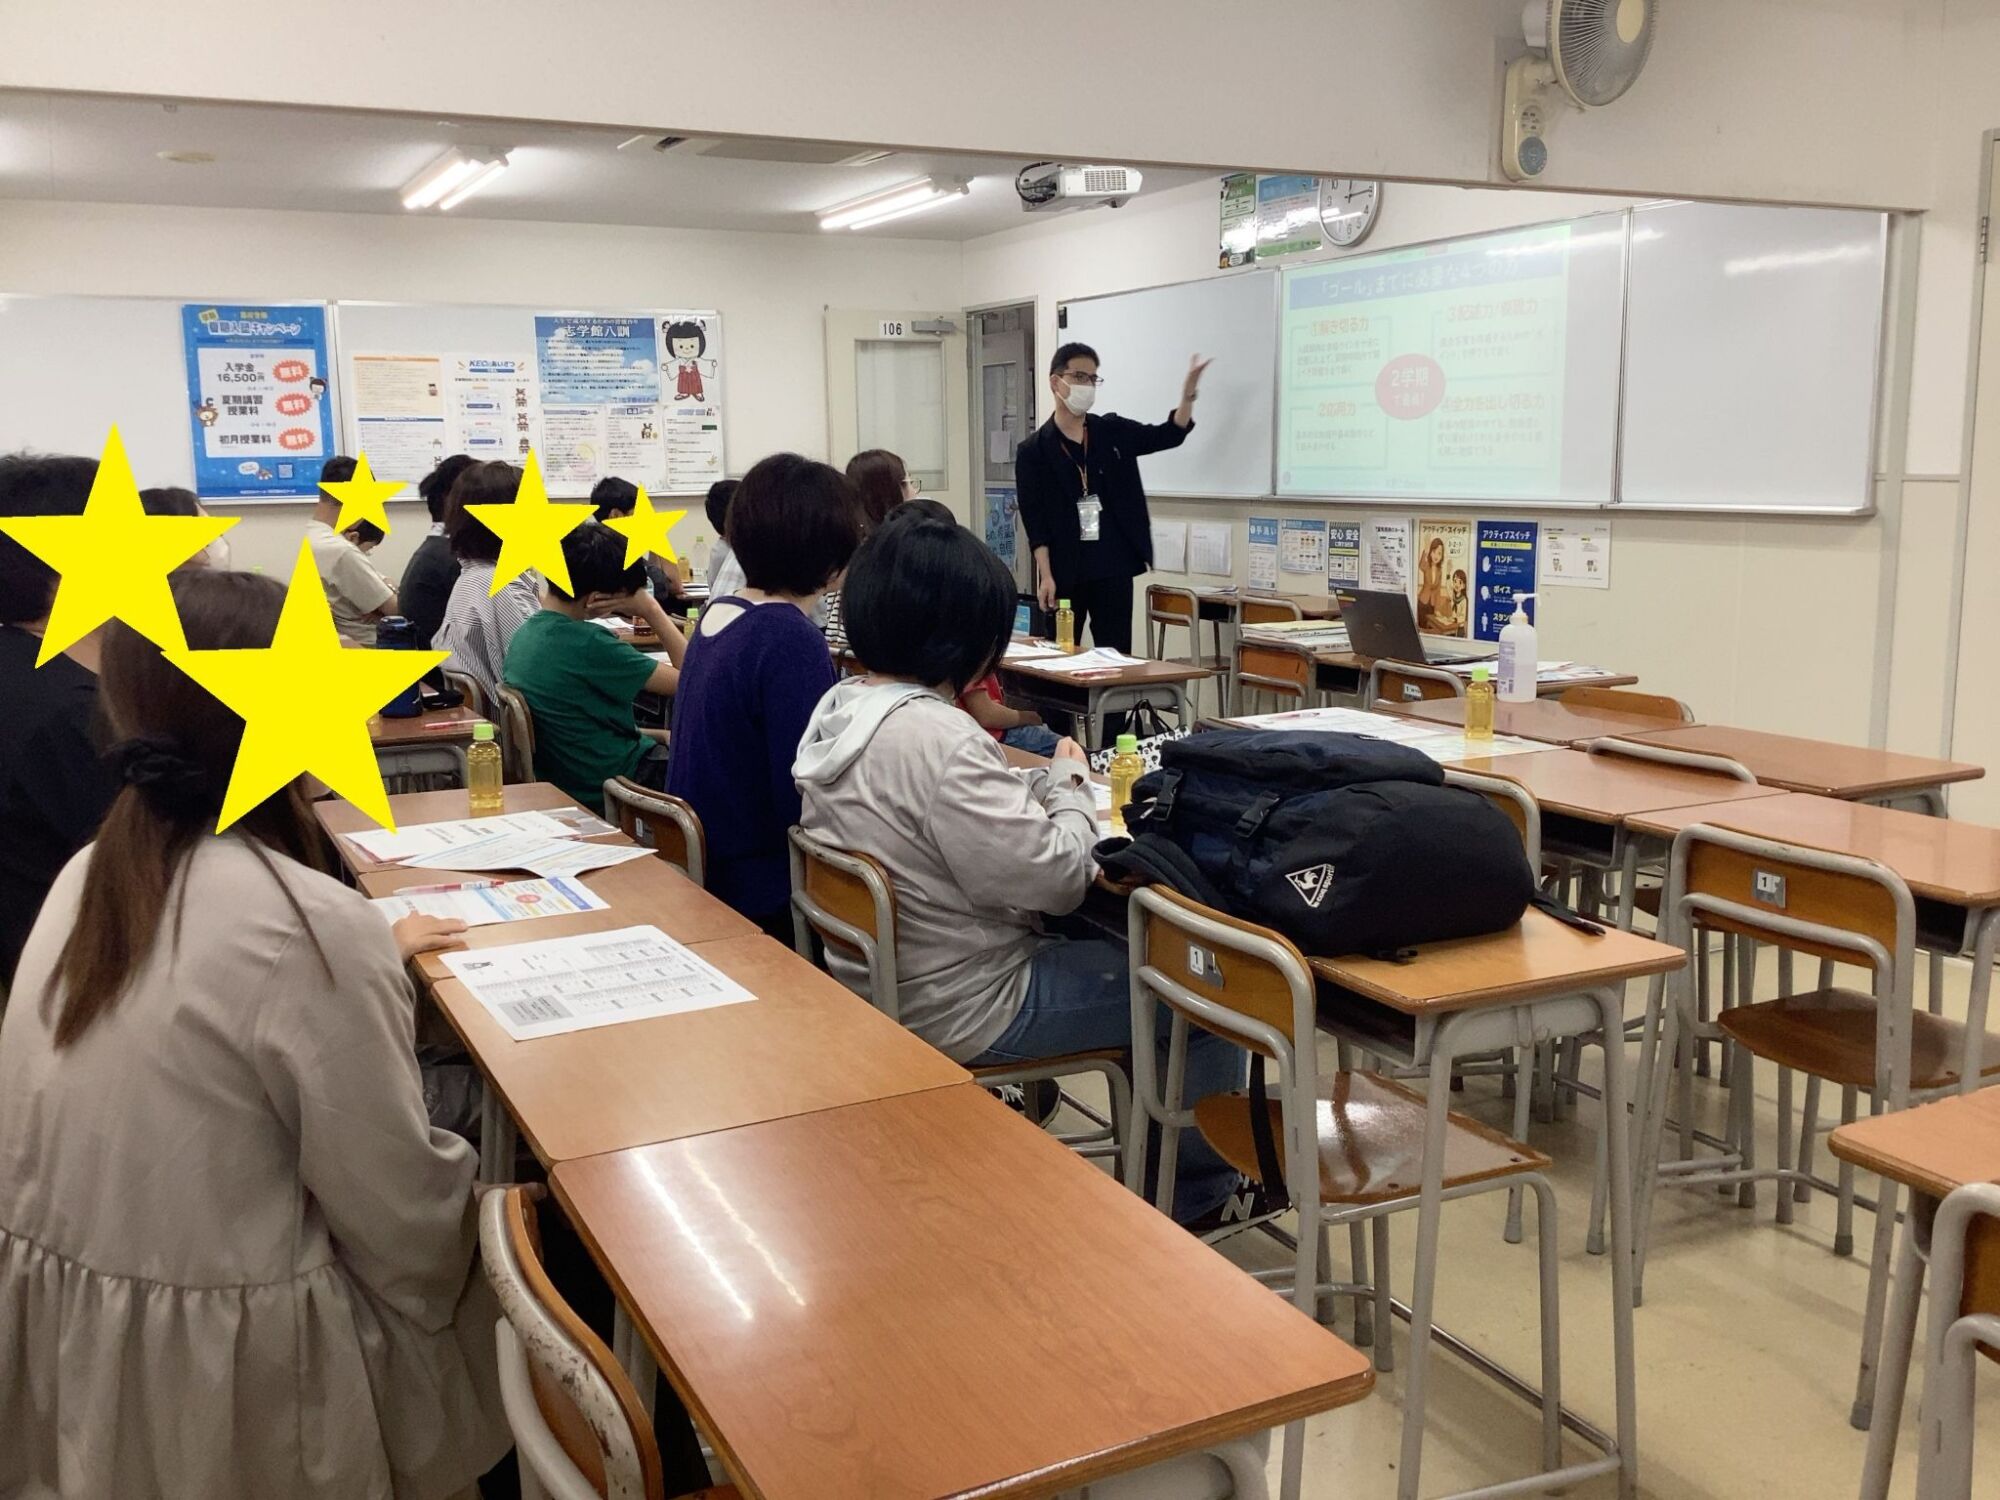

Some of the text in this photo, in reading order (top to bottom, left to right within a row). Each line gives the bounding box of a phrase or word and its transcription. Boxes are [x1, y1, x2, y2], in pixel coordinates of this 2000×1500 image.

[1363, 204, 1369, 215] 4
[563, 325, 630, 338] 志学館八訓
[882, 322, 902, 335] 106
[225, 362, 254, 372] 入学金
[280, 366, 303, 377] 無料
[217, 373, 265, 383] 16,500円
[1391, 366, 1430, 388] 2学期
[222, 394, 264, 405] 夏期講習
[282, 398, 305, 410] 無料
[227, 405, 259, 416] 授業料
[219, 434, 272, 445] 初月授業料
[286, 434, 309, 446] 無料
[1330, 528, 1359, 541] 安心 安全
[1483, 530, 1532, 541] アクティブスイッチ
[1494, 555, 1513, 563] ハンド
[1493, 586, 1511, 594] ボイス
[1322, 863, 1336, 889] sportif
[1762, 876, 1768, 888] 1
[1317, 889, 1328, 902] coq
[1194, 951, 1199, 964] 1
[1221, 1192, 1254, 1221] N
